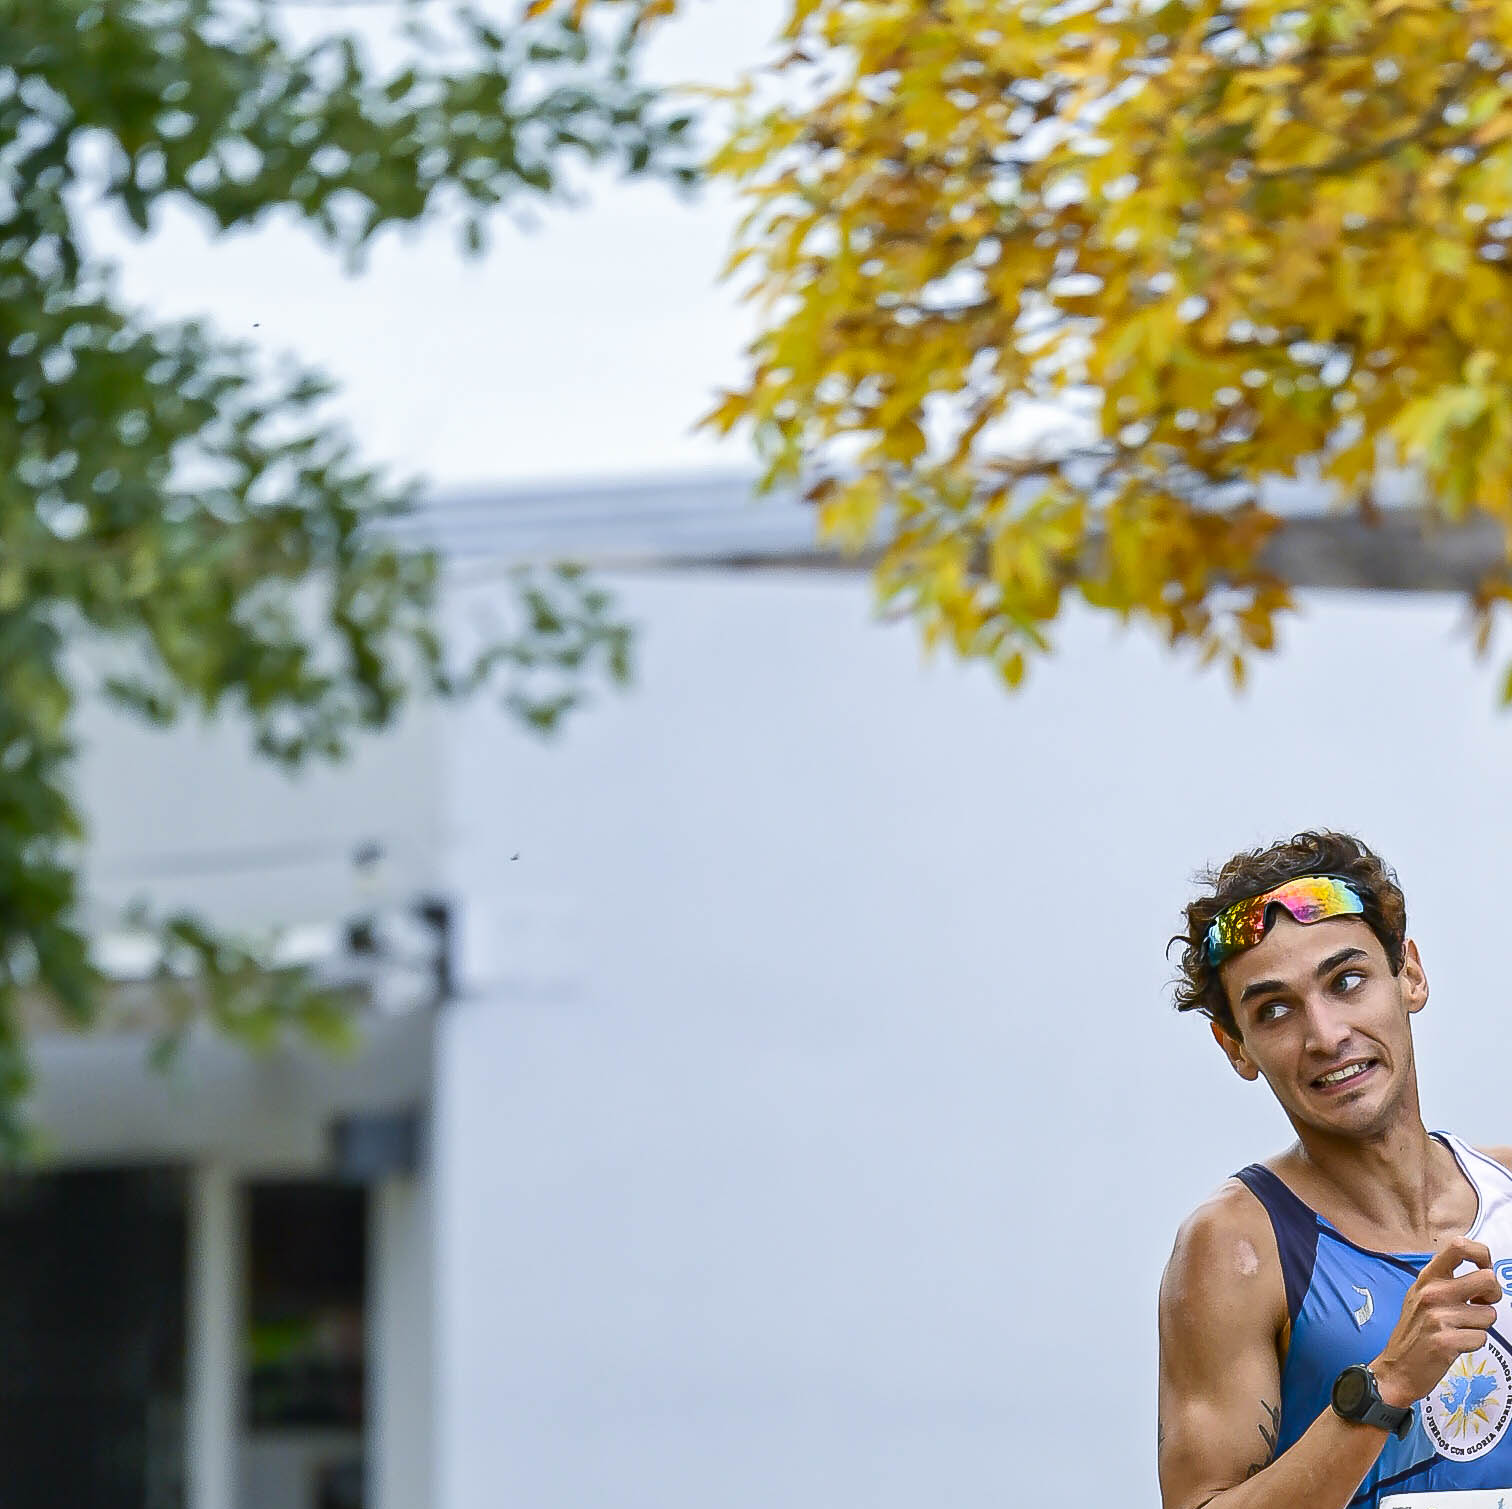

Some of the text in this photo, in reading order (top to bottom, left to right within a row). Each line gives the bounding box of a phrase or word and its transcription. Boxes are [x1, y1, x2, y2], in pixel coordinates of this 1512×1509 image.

[1488, 1342, 1512, 1382] VIVAMOS
[1425, 1405, 1432, 1414] O
[1466, 1432, 1497, 1455] GLORIA
